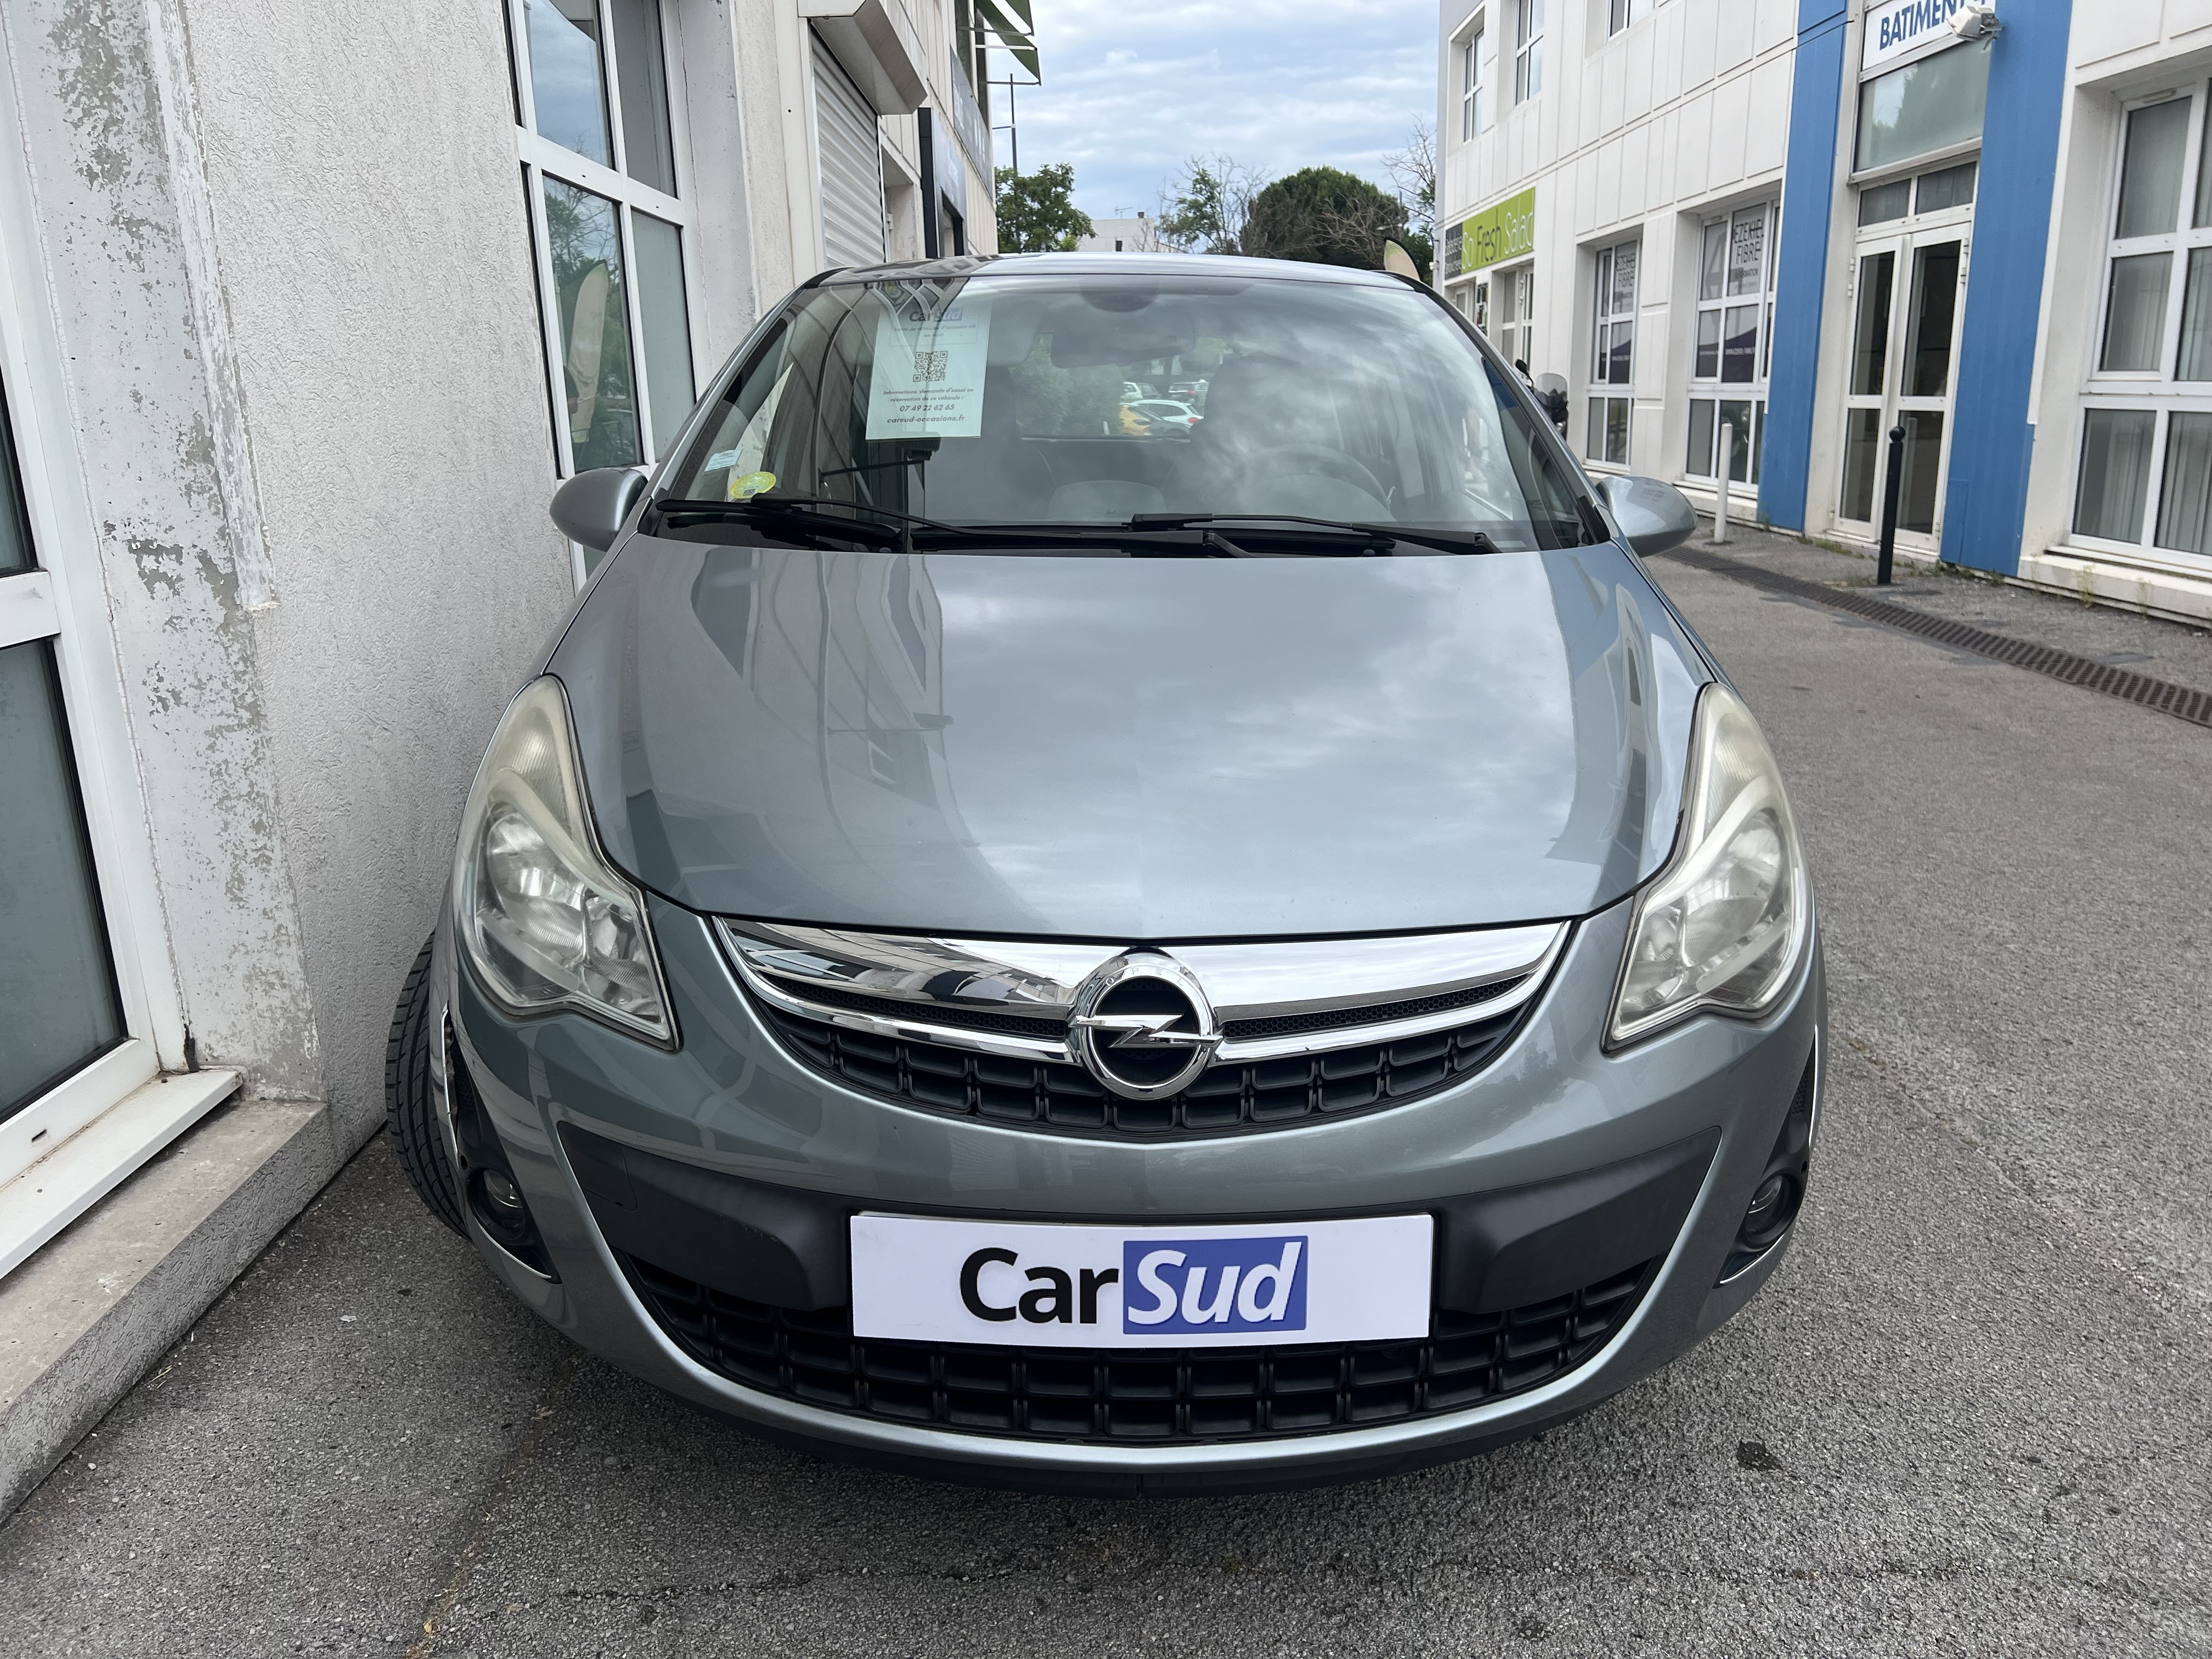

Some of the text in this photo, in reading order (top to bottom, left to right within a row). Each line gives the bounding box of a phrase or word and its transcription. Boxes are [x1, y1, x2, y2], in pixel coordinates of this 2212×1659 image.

[1880, 0, 1966, 50] BATIMEN
[1462, 190, 1534, 270] So Fresh Salad
[1736, 241, 1761, 265] FIBRE
[887, 414, 966, 424] carsud-occasions.fr
[1105, 967, 1183, 987] OPEL
[959, 1242, 1302, 1325] CarSud
